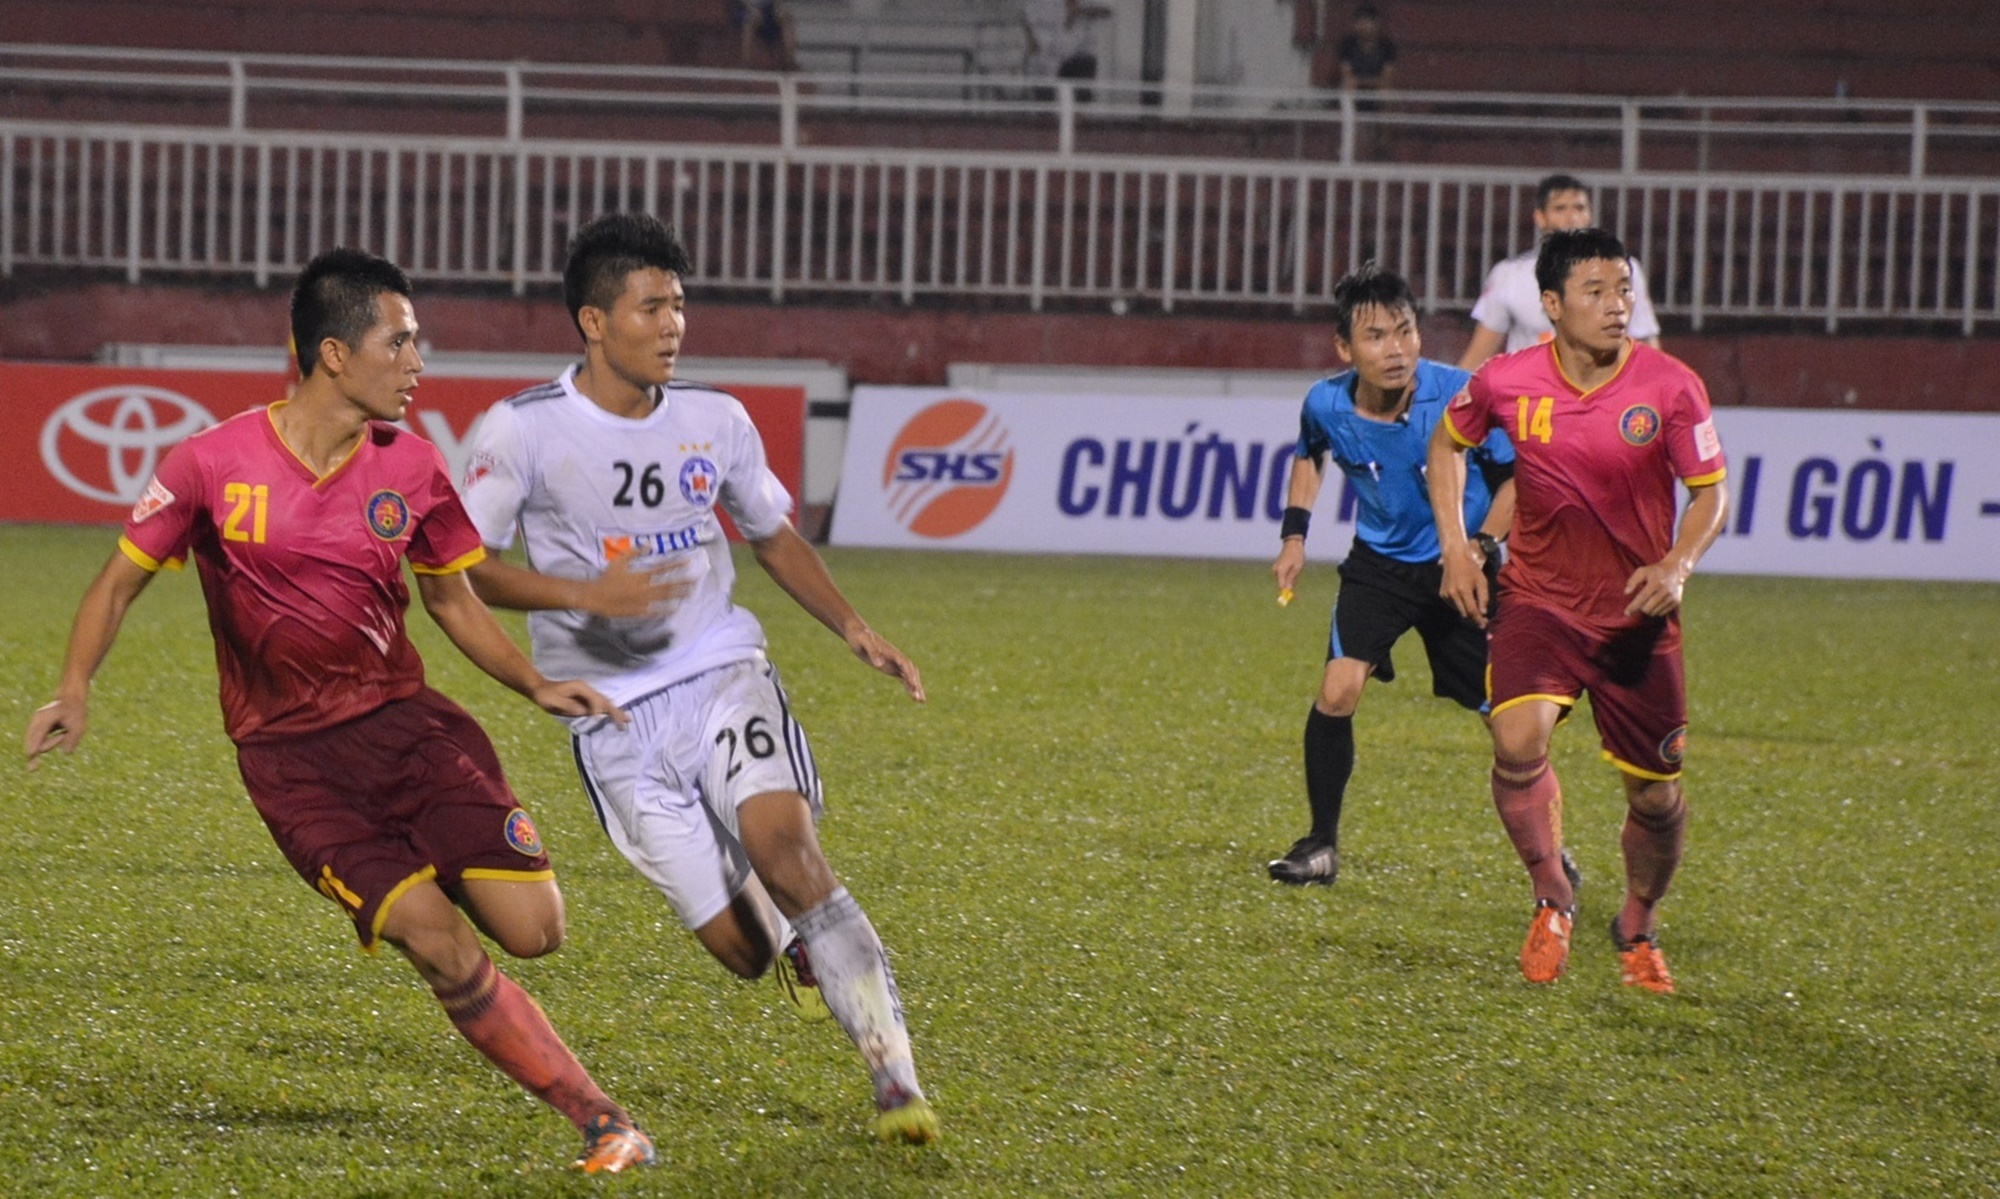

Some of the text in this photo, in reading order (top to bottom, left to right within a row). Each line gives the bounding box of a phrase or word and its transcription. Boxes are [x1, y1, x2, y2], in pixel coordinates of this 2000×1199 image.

[1517, 396, 1554, 444] 14
[613, 461, 664, 508] 26
[897, 452, 1003, 481] SHS
[1786, 435, 1955, 541] GÒN
[223, 482, 268, 544] 21
[714, 715, 776, 783] 26
